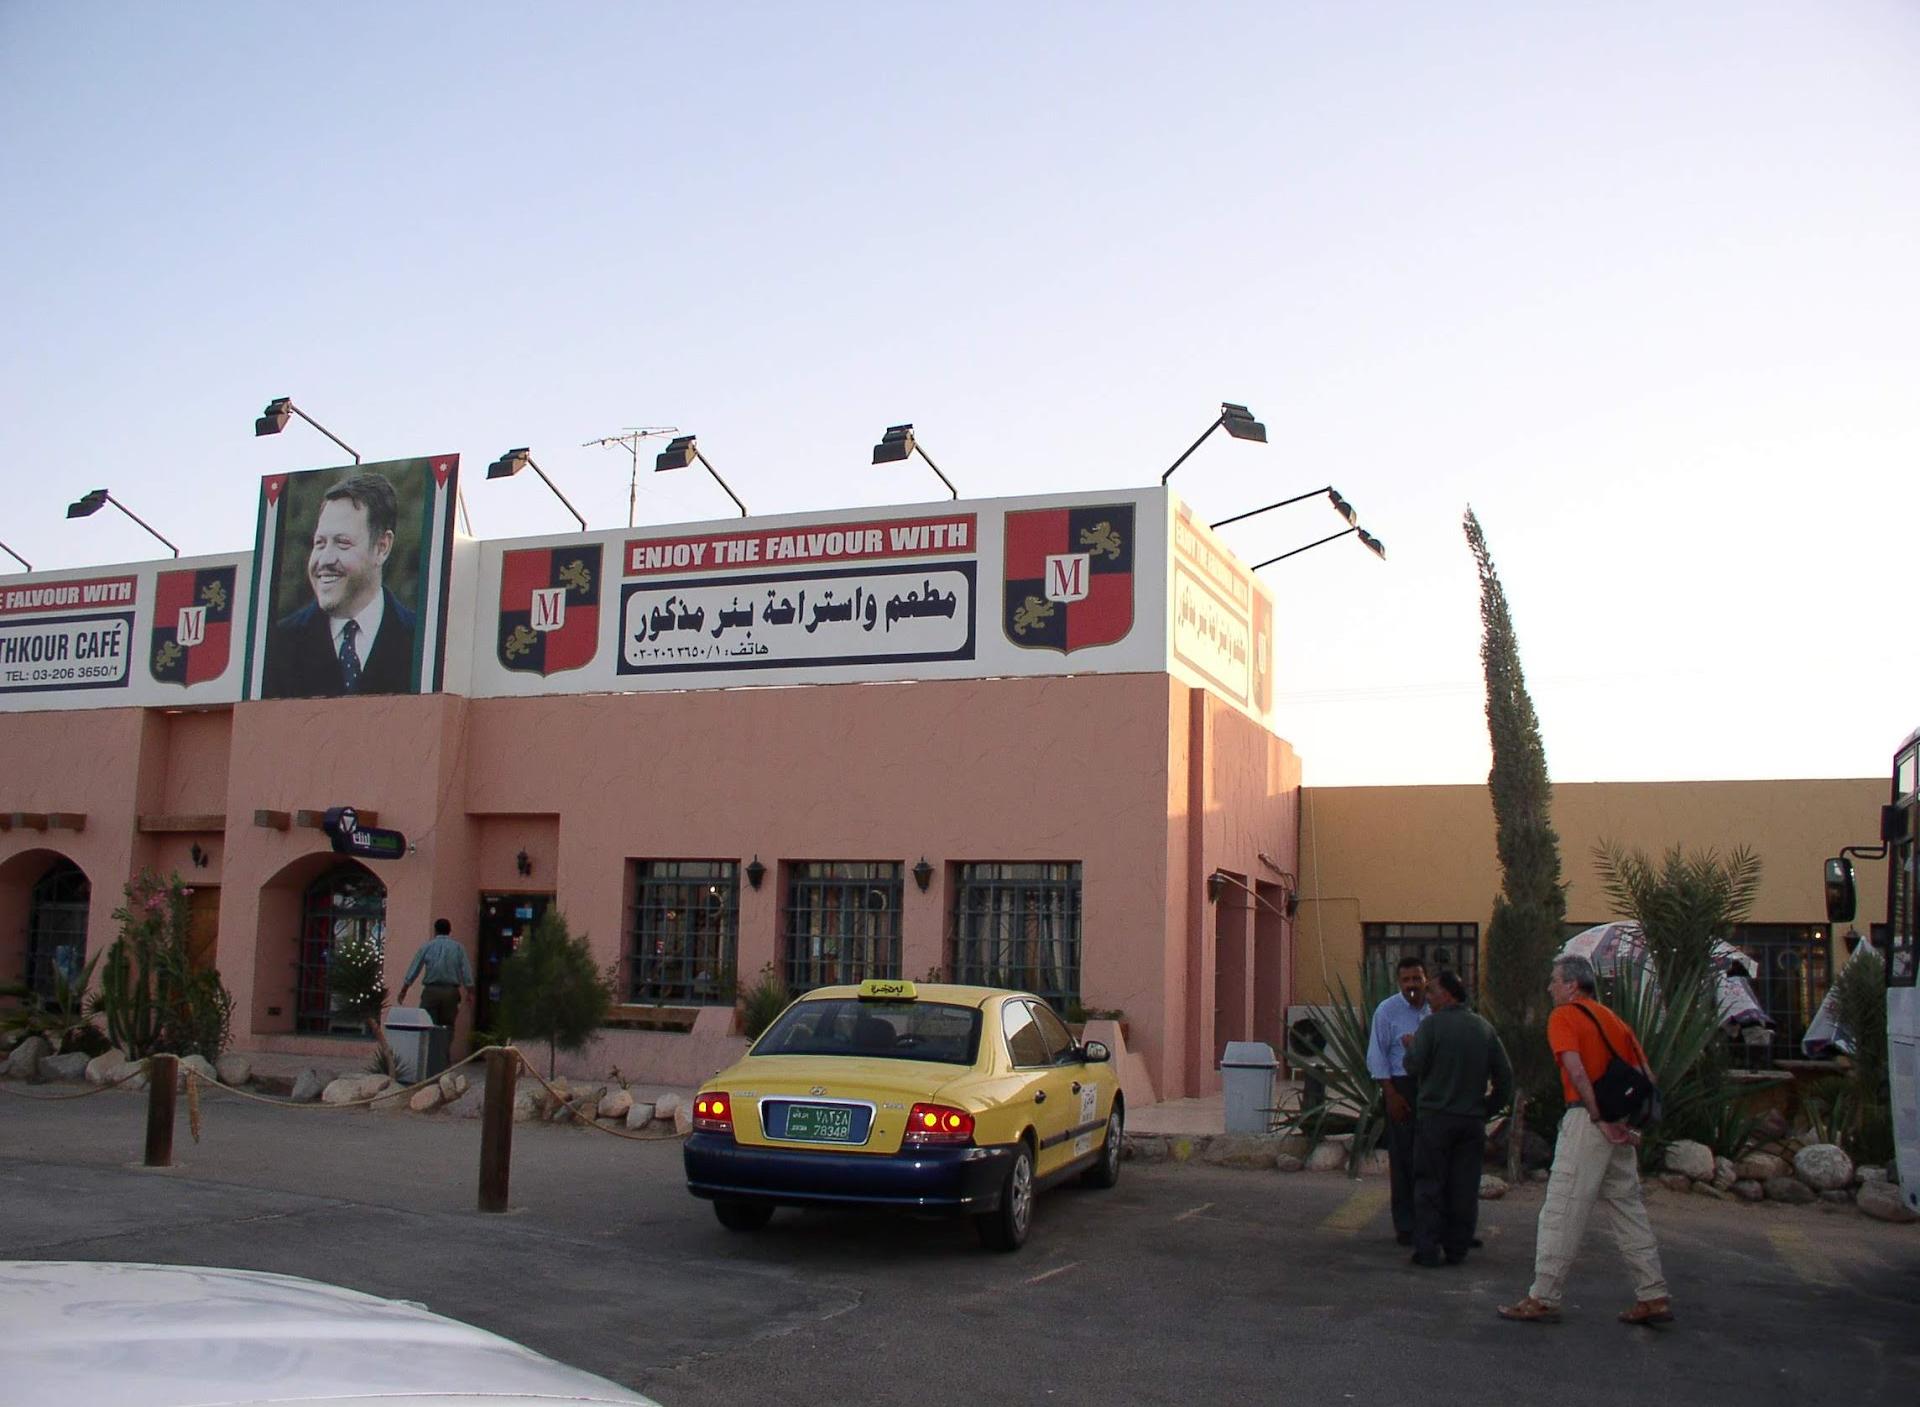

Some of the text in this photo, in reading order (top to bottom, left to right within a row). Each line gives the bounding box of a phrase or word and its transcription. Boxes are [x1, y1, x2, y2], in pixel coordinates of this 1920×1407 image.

[632, 523, 967, 570] ENJOY THE FALVOUR WITH
[1052, 558, 1083, 596] M
[6, 587, 80, 608] FALVOUR
[83, 582, 131, 602] WITH
[536, 592, 560, 626] M
[634, 580, 956, 643] مطعم واستراحة بئر مذكور
[75, 622, 122, 660] CAFÉ
[180, 610, 201, 641] M
[6, 666, 117, 681] TEL: 03-206 3650/1
[814, 1125, 847, 1137] 78348
